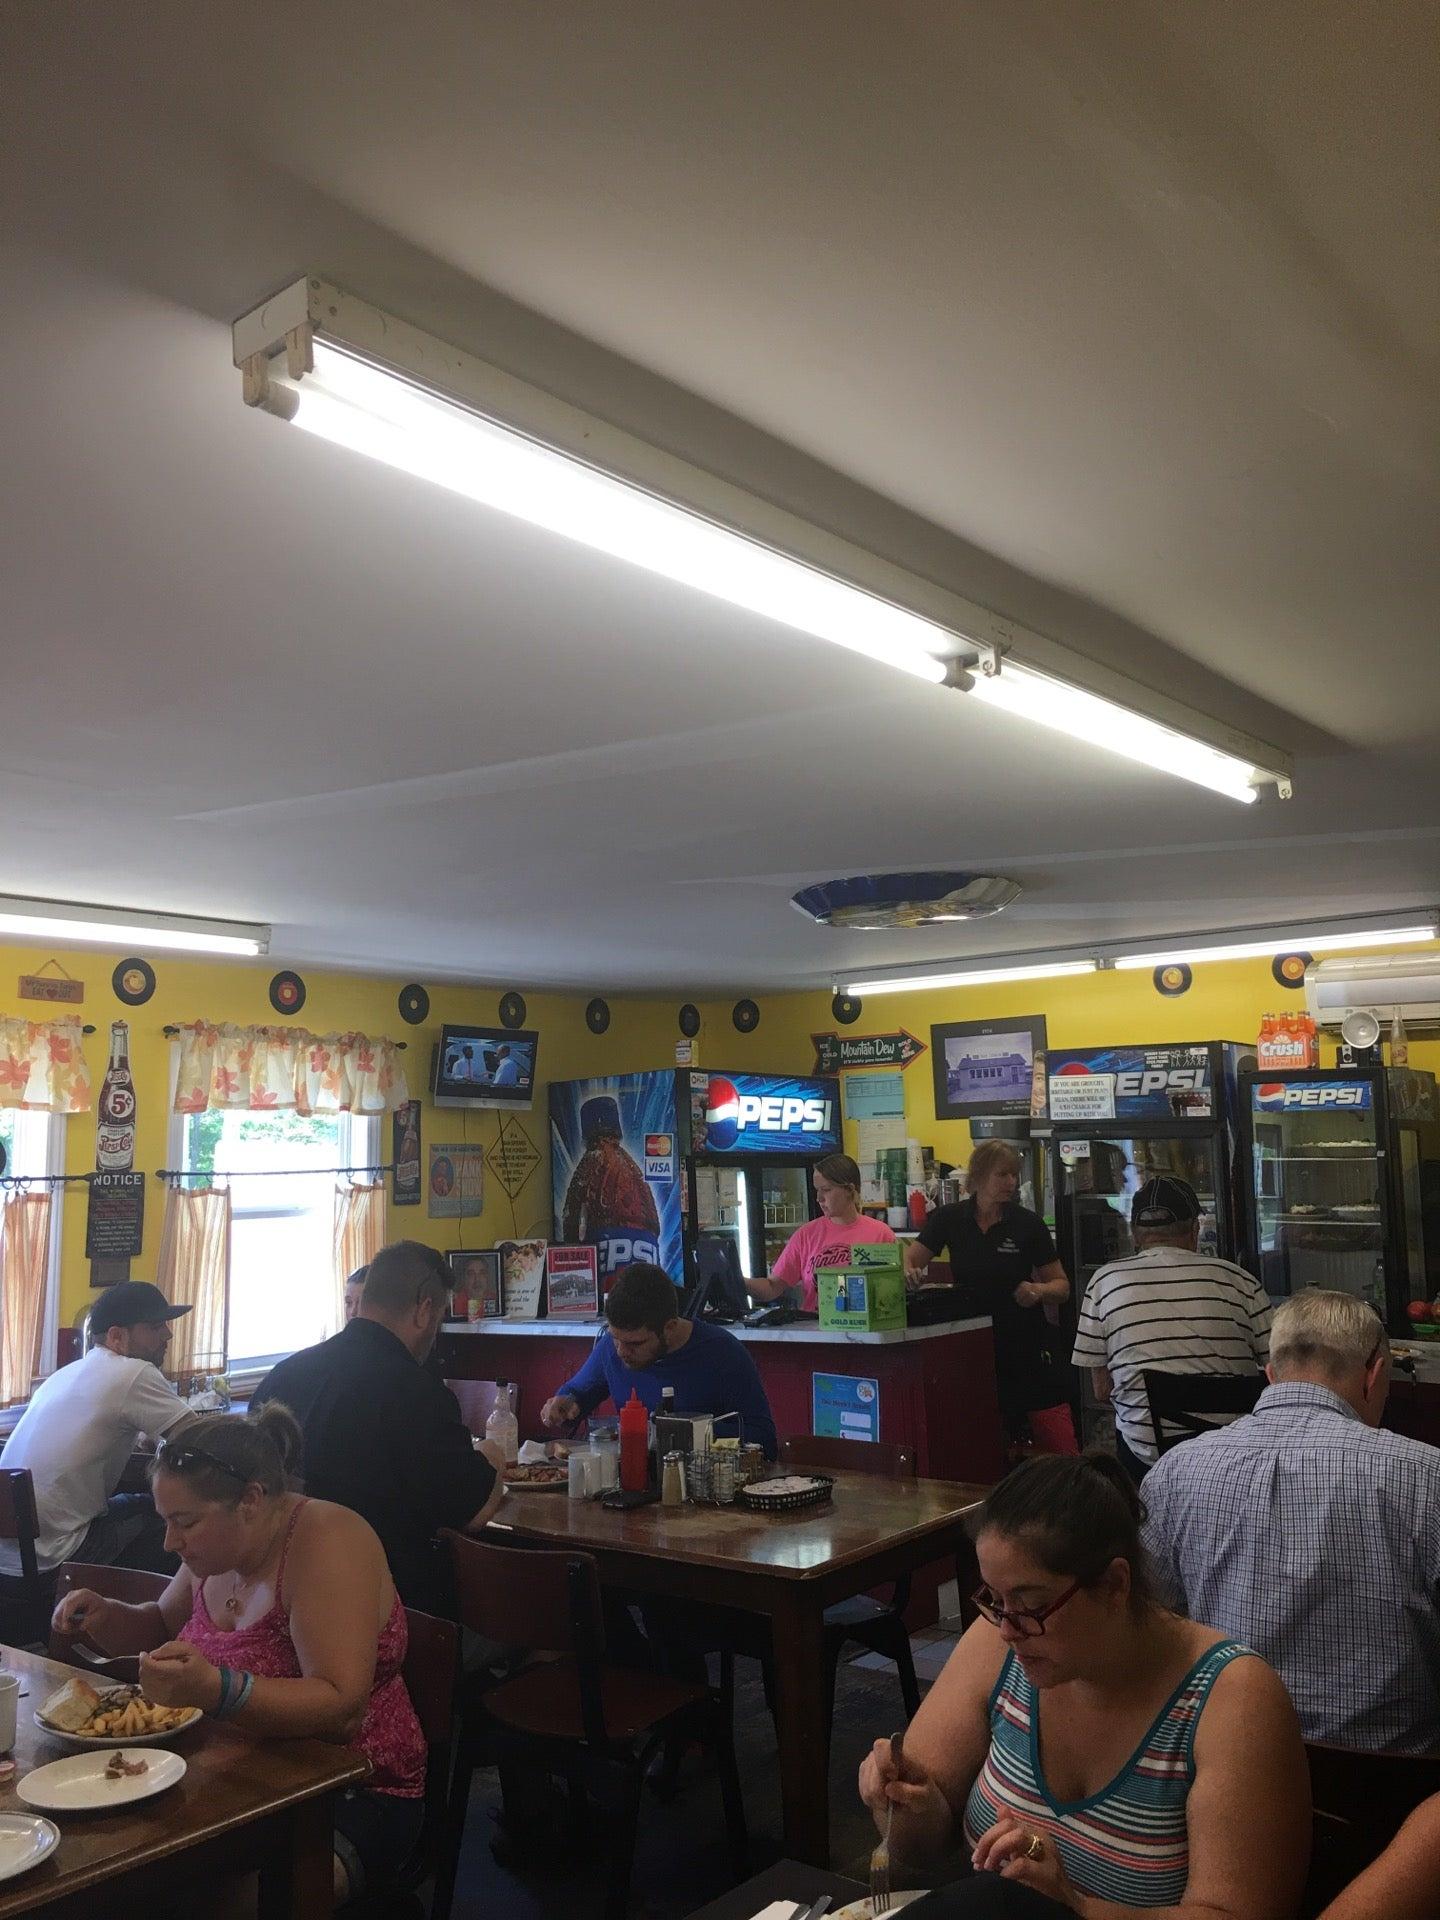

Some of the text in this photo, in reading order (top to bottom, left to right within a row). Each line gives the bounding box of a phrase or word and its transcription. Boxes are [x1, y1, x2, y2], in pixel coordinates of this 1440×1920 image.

[840, 1039, 895, 1058] Mountain Dew
[1260, 1042, 1303, 1057] Crush
[1115, 1069, 1206, 1097] EPSI
[1284, 1088, 1363, 1106] PEPSI
[737, 1096, 832, 1131] PEPSI
[649, 1163, 670, 1172] VISA
[94, 1175, 141, 1185] NOTICE
[555, 1250, 589, 1261] FOR SALE
